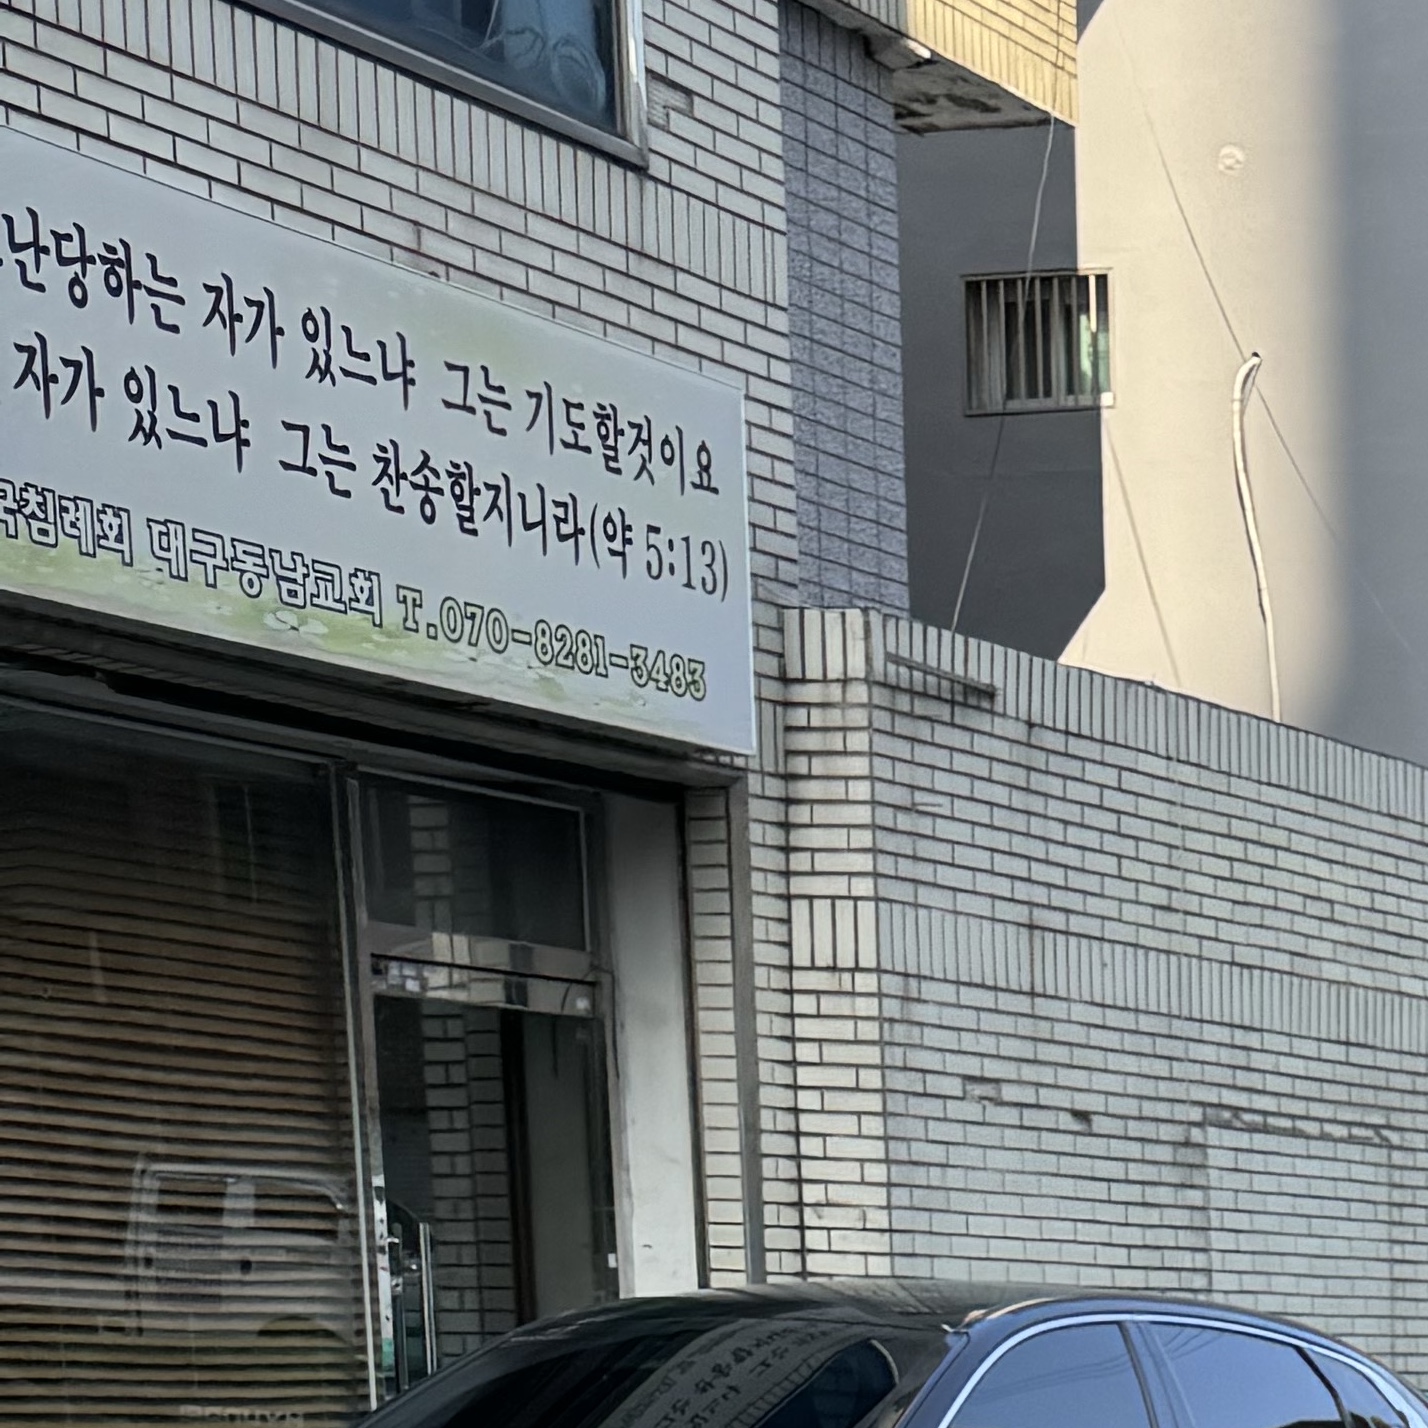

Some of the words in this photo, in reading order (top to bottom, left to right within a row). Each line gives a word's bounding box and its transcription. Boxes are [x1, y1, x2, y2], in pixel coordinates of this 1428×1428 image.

[0, 207, 186, 335] 난당하는
[202, 272, 285, 369] 자가
[301, 306, 416, 411] 있느냐
[441, 360, 512, 437] 그는
[525, 381, 719, 496] 기도할것이요
[13, 331, 105, 433] 자가
[124, 364, 250, 474] 있느냐
[279, 420, 357, 499] 그는
[147, 517, 383, 629] 대구동남교회
